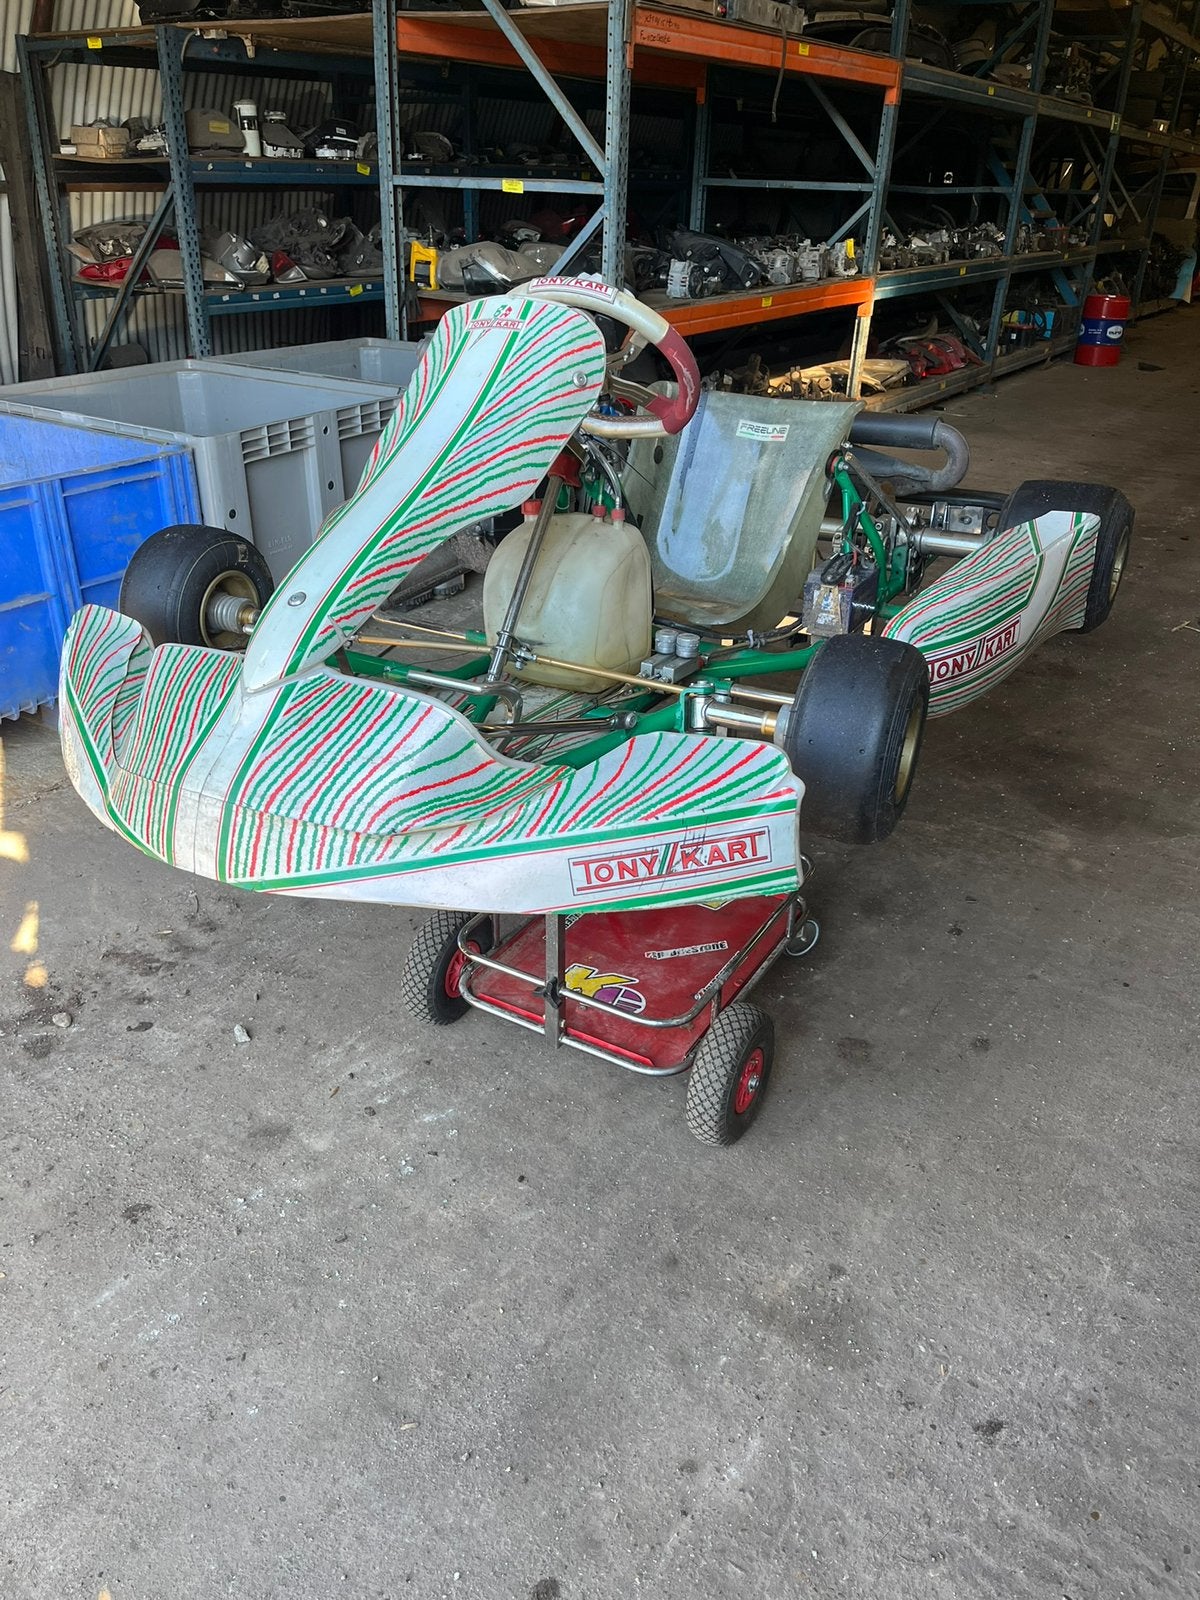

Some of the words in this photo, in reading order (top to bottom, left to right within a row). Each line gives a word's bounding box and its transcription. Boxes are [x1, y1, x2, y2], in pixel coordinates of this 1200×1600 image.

[574, 278, 609, 293] KART
[495, 319, 521, 330] KART
[740, 422, 788, 435] FREELINE
[985, 620, 1020, 660] KART
[573, 850, 659, 885] TONY
[679, 831, 766, 869] KART
